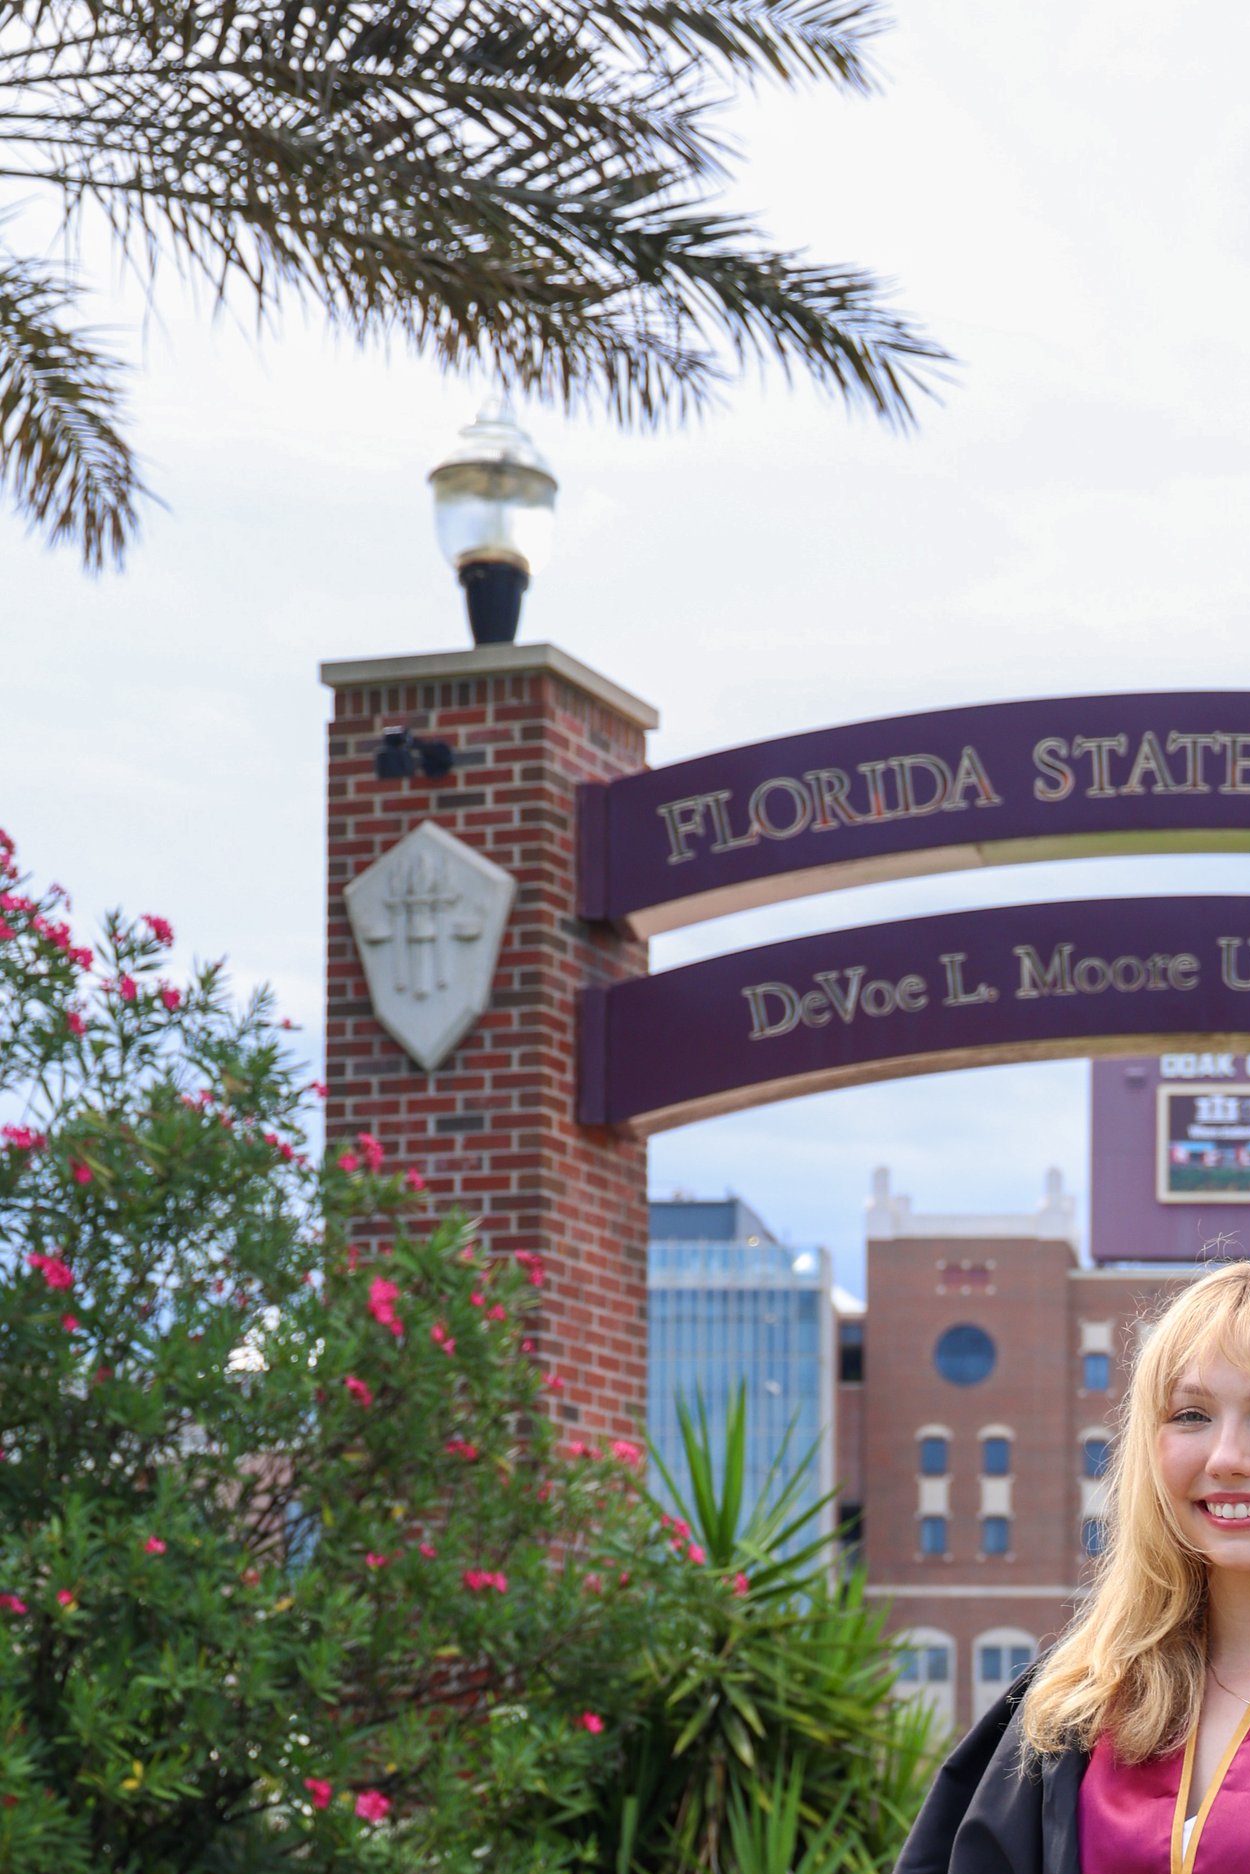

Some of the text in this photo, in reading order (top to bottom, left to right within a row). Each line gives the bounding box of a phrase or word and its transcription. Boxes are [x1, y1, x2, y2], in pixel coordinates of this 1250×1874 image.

[656, 745, 1002, 865] FLORIDA
[741, 965, 928, 1040] DeVoe
[939, 952, 998, 1007] L.
[1013, 944, 1199, 1000] Moore
[1159, 1053, 1237, 1079] DOAK
